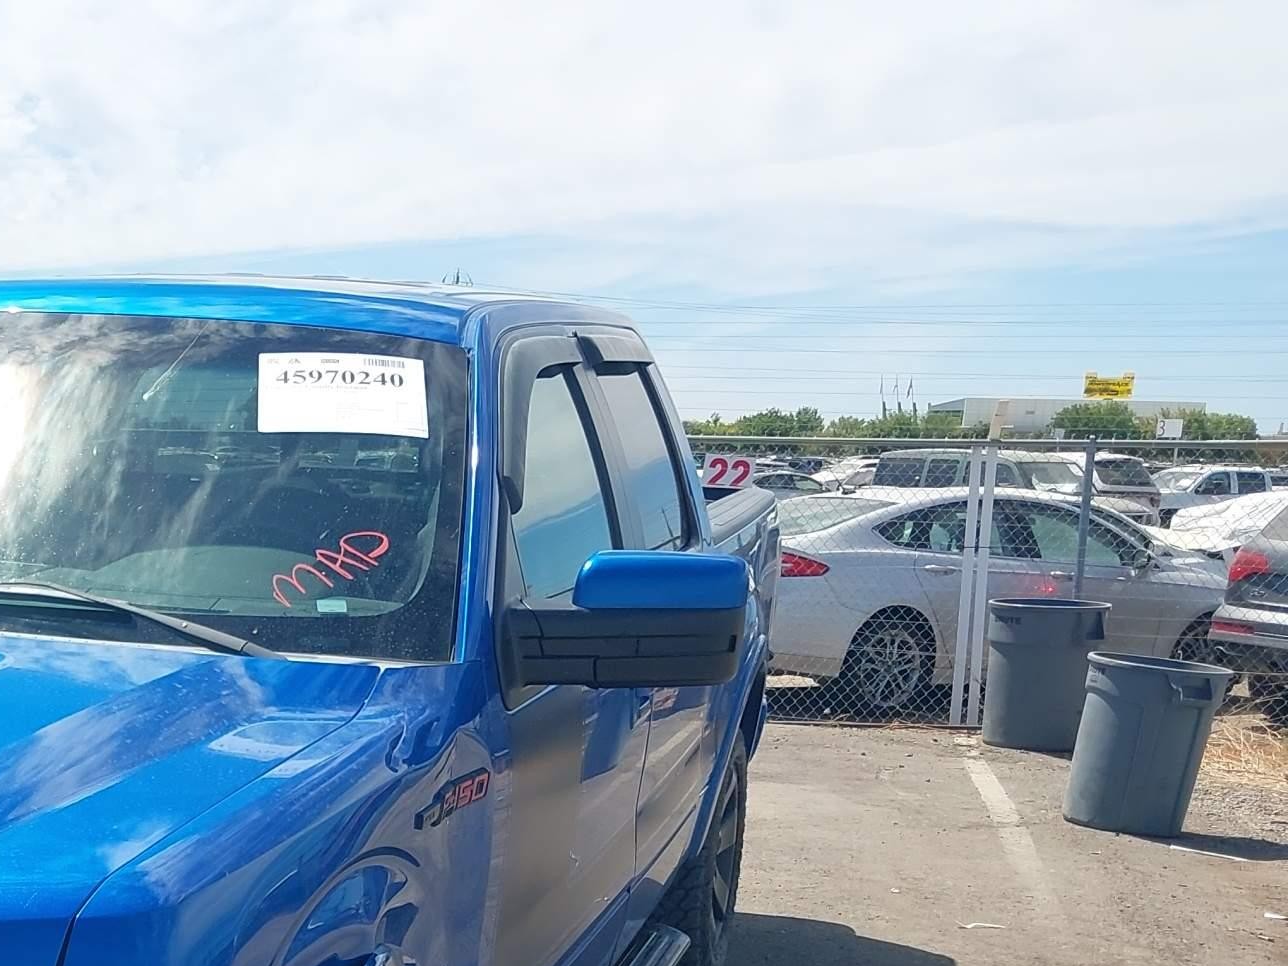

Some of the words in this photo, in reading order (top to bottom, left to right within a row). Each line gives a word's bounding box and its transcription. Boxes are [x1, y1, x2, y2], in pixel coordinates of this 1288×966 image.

[276, 368, 405, 388] 45970240
[707, 457, 751, 487] 22
[272, 530, 391, 609] MAD
